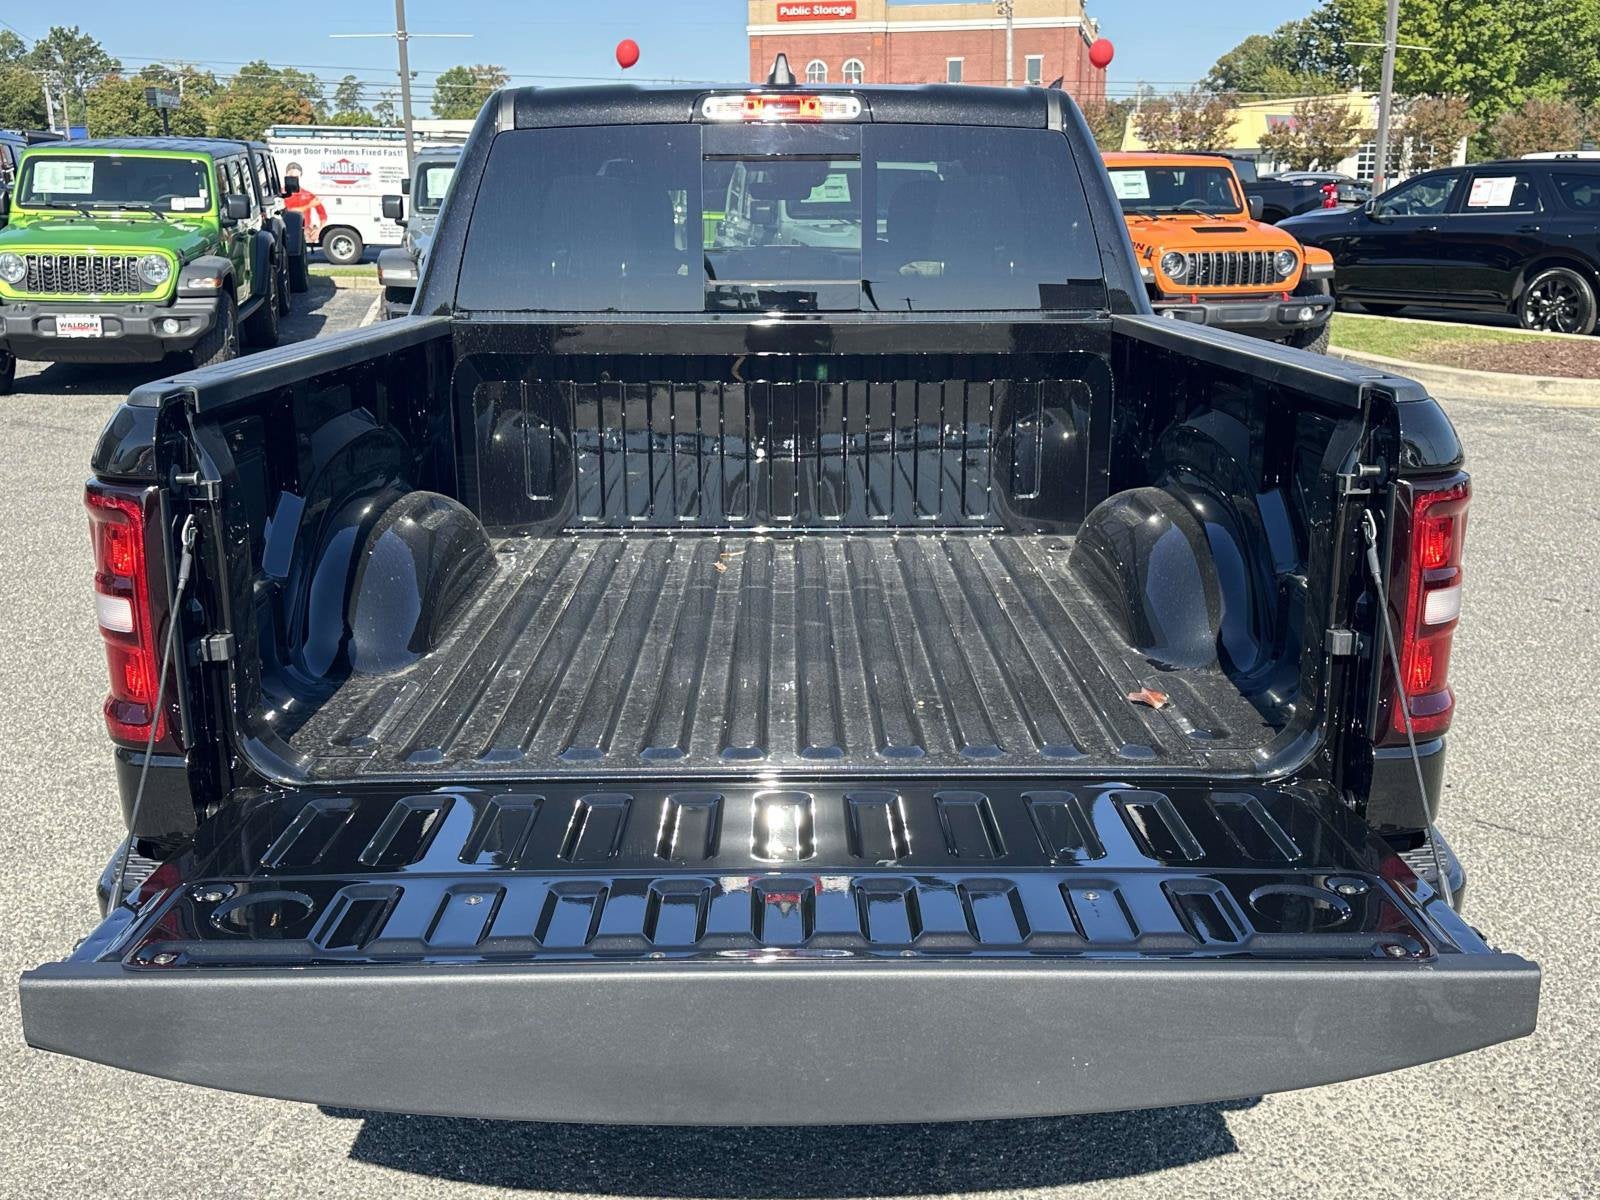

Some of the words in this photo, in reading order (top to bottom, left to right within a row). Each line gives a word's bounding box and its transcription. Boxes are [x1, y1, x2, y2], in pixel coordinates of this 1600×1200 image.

[780, 6, 811, 16] Public
[813, 5, 852, 17] Storage
[274, 146, 302, 156] Garage
[304, 147, 321, 156] Door
[324, 147, 359, 157] Problems
[361, 148, 382, 157] Fixed
[383, 149, 403, 158] Fast!
[320, 162, 369, 174] ACADEMY
